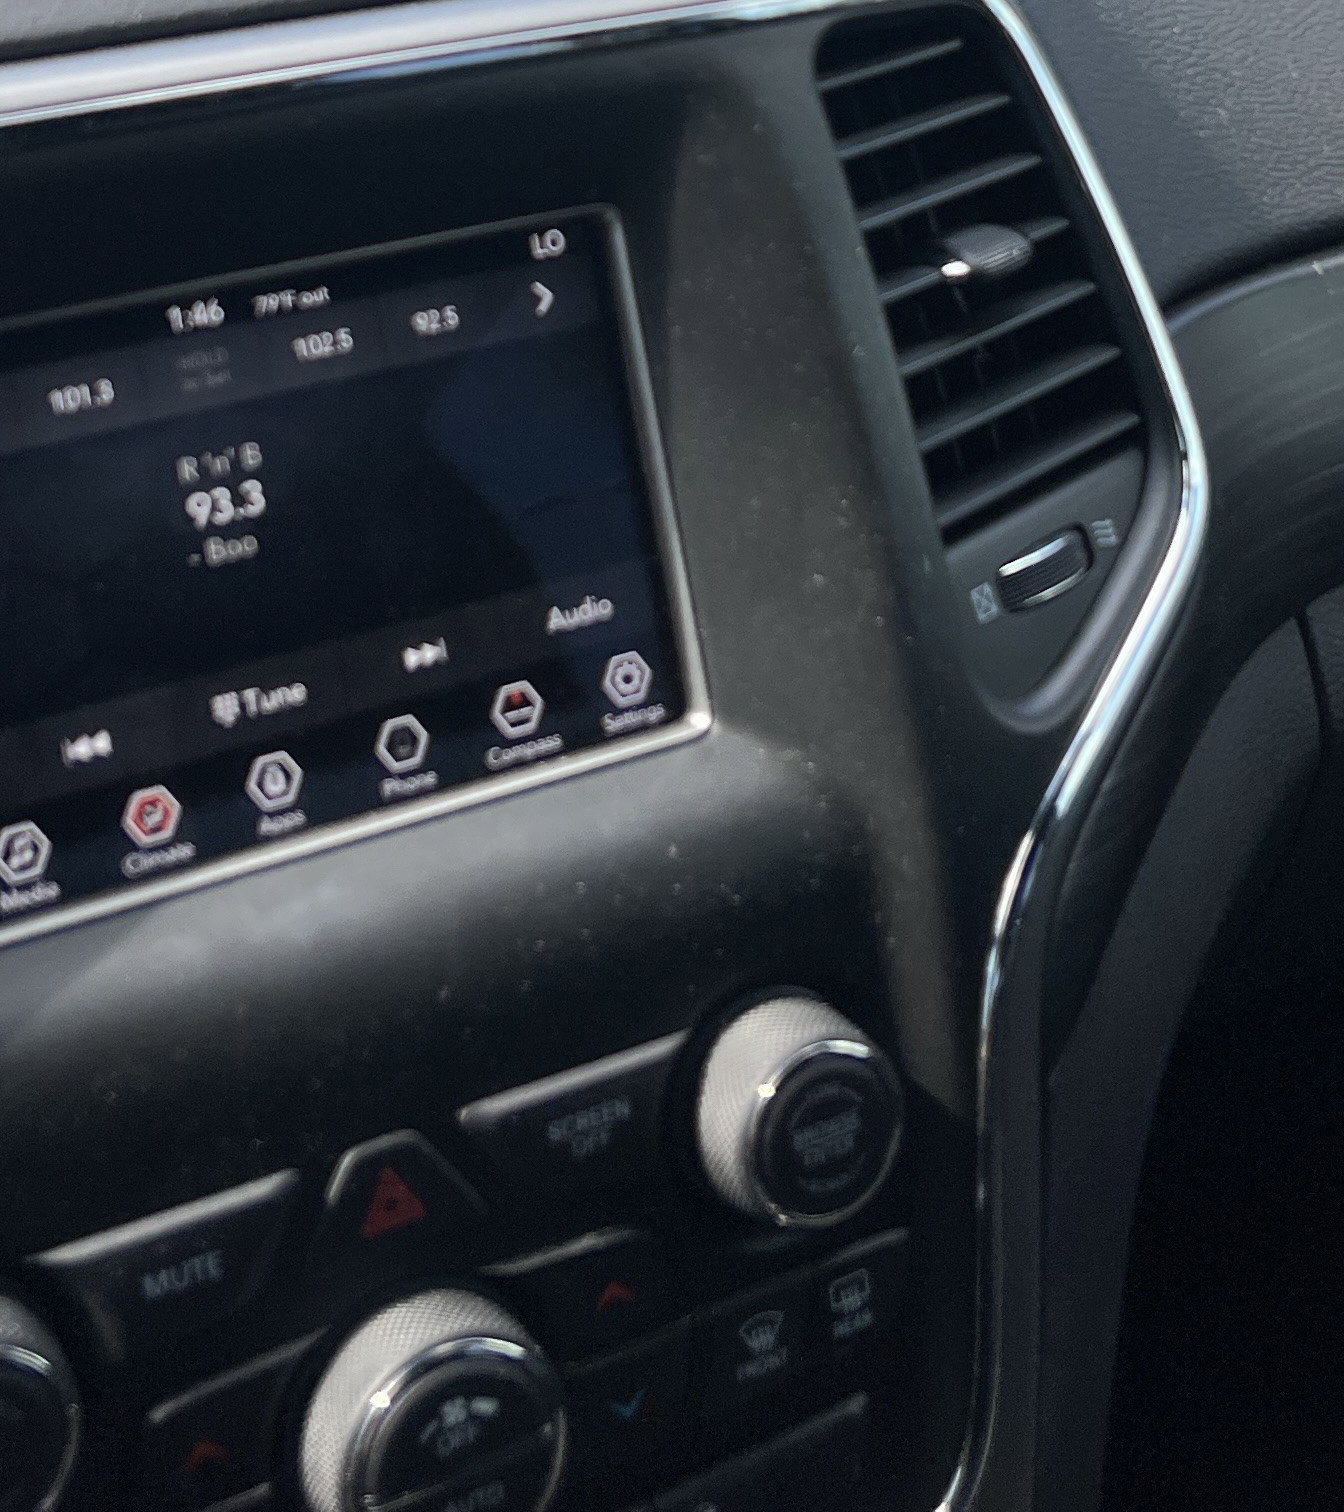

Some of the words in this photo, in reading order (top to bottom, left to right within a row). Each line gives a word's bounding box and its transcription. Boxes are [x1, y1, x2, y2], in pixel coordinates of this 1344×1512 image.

[529, 229, 566, 260] LO
[166, 296, 225, 334] 1:46
[297, 285, 331, 310] out
[291, 327, 354, 361] 102.5
[410, 305, 460, 336] 92.5
[185, 479, 267, 531] 93.3
[546, 594, 615, 635] Audio
[242, 682, 309, 718] Tune
[601, 702, 666, 735] Settings
[484, 731, 564, 771] Compass
[547, 1096, 632, 1143] SCREEN
[571, 1120, 612, 1157] OFF
[140, 1249, 224, 1300] MUTE
